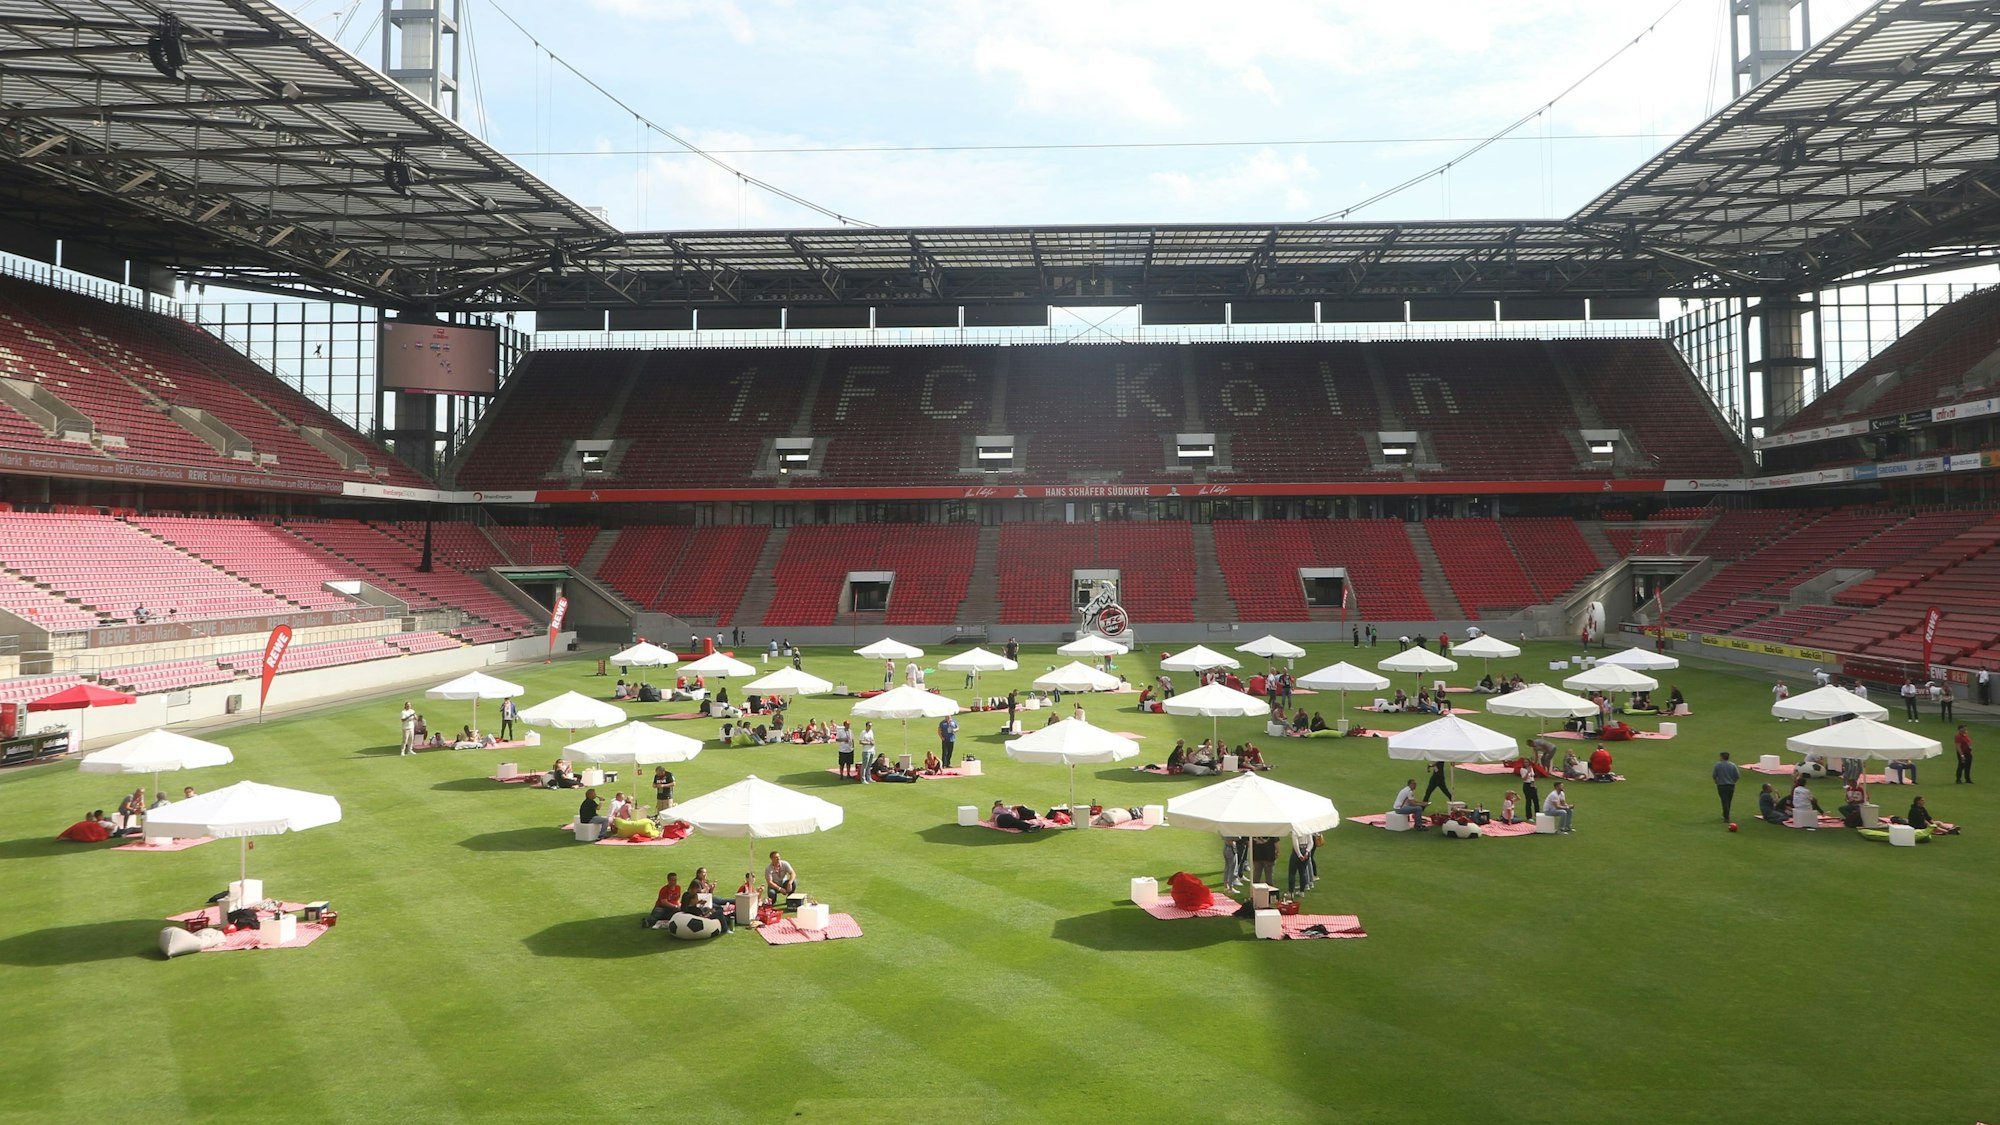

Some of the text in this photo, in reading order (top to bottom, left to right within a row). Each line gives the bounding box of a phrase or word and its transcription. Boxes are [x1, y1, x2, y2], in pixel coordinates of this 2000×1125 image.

[729, 361, 1460, 421] 1. FC Köln
[29, 456, 58, 469] Herzlich
[59, 460, 99, 472] willkommen
[100, 464, 114, 473] zum
[115, 463, 135, 475] REWE
[188, 469, 207, 481] REWE
[1045, 486, 1150, 497] HANS SCHÄFER SÜDKURVE
[551, 599, 568, 629] REWE
[1925, 610, 1939, 643] REWE
[99, 629, 130, 645] REWE
[135, 627, 152, 642] Dein
[155, 625, 178, 640] Markt
[191, 621, 216, 637] REWE
[220, 621, 235, 634] Dein
[238, 619, 257, 633] Markt
[266, 632, 289, 668] REWE
[1930, 667, 1968, 682] EWE REW
